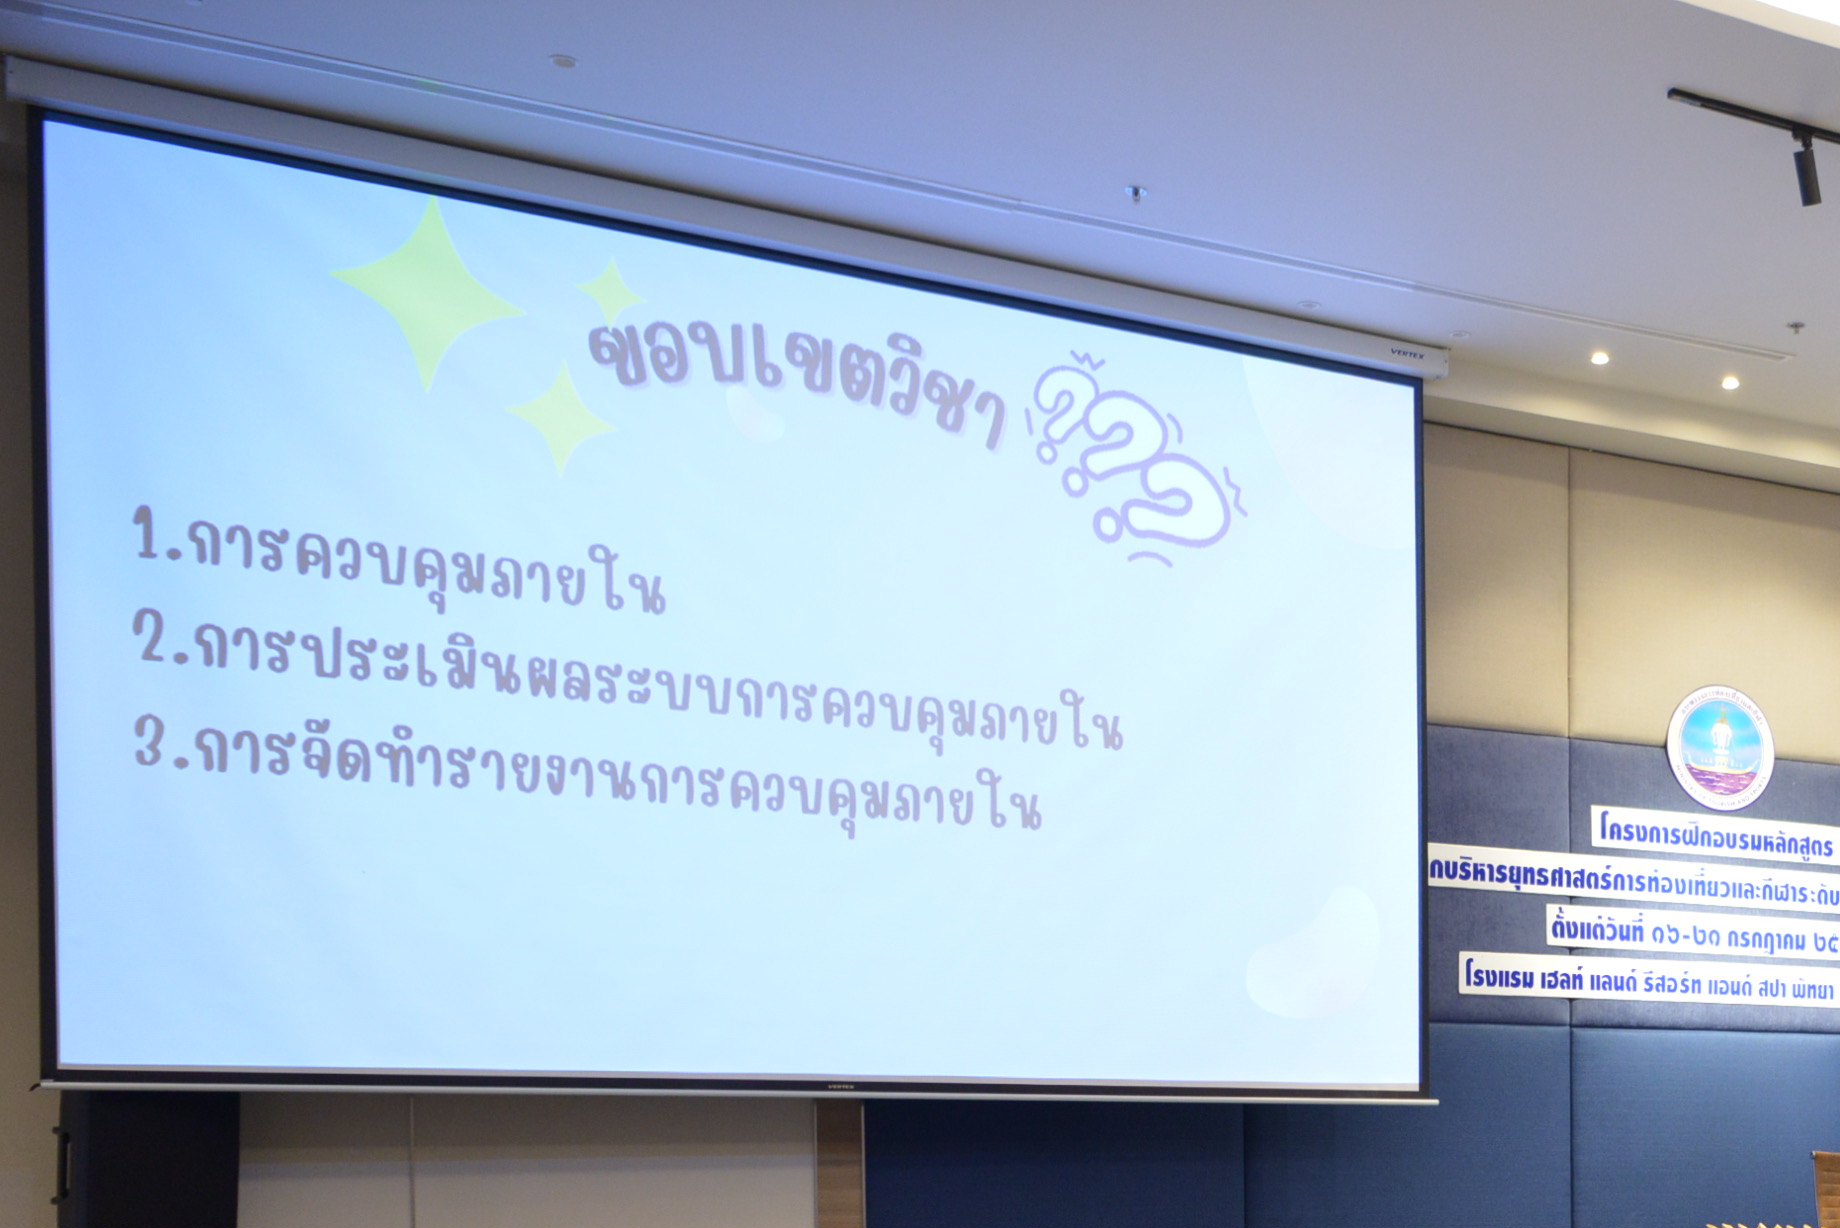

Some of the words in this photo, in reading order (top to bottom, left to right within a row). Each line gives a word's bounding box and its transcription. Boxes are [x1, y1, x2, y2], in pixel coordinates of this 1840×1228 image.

[1391, 347, 1425, 360] VERTEX
[587, 320, 1007, 453] ขอบเขตวิชา
[1551, 906, 1645, 943] ตั้งแต่วันที่
[1727, 930, 1806, 955] กรกฎาคม
[1465, 957, 1535, 988] โรงแรม
[1589, 968, 1638, 992] แลนด์
[1708, 973, 1752, 997] แอนด์
[1758, 979, 1787, 998] สปา
[1792, 977, 1834, 1000] พัทยา
